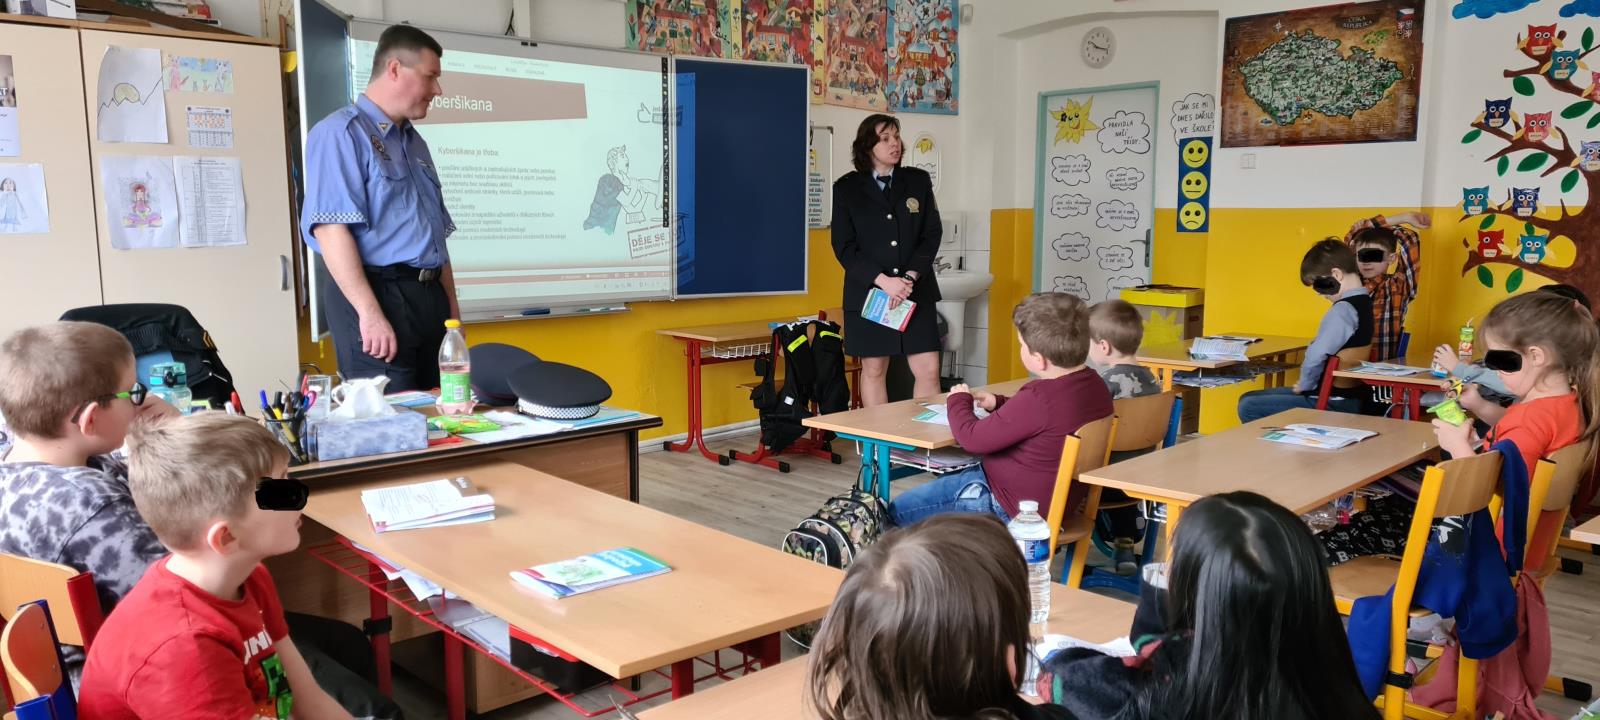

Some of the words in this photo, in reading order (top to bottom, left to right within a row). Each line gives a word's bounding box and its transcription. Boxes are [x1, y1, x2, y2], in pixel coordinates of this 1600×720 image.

[428, 95, 493, 112] yberšikana
[1192, 102, 1200, 110] SE
[1177, 114, 1193, 122] DNES
[1108, 120, 1134, 128] PRAVIDLA
[1180, 126, 1189, 134] VE
[631, 234, 652, 248] DĚJE
[654, 232, 665, 242] SE
